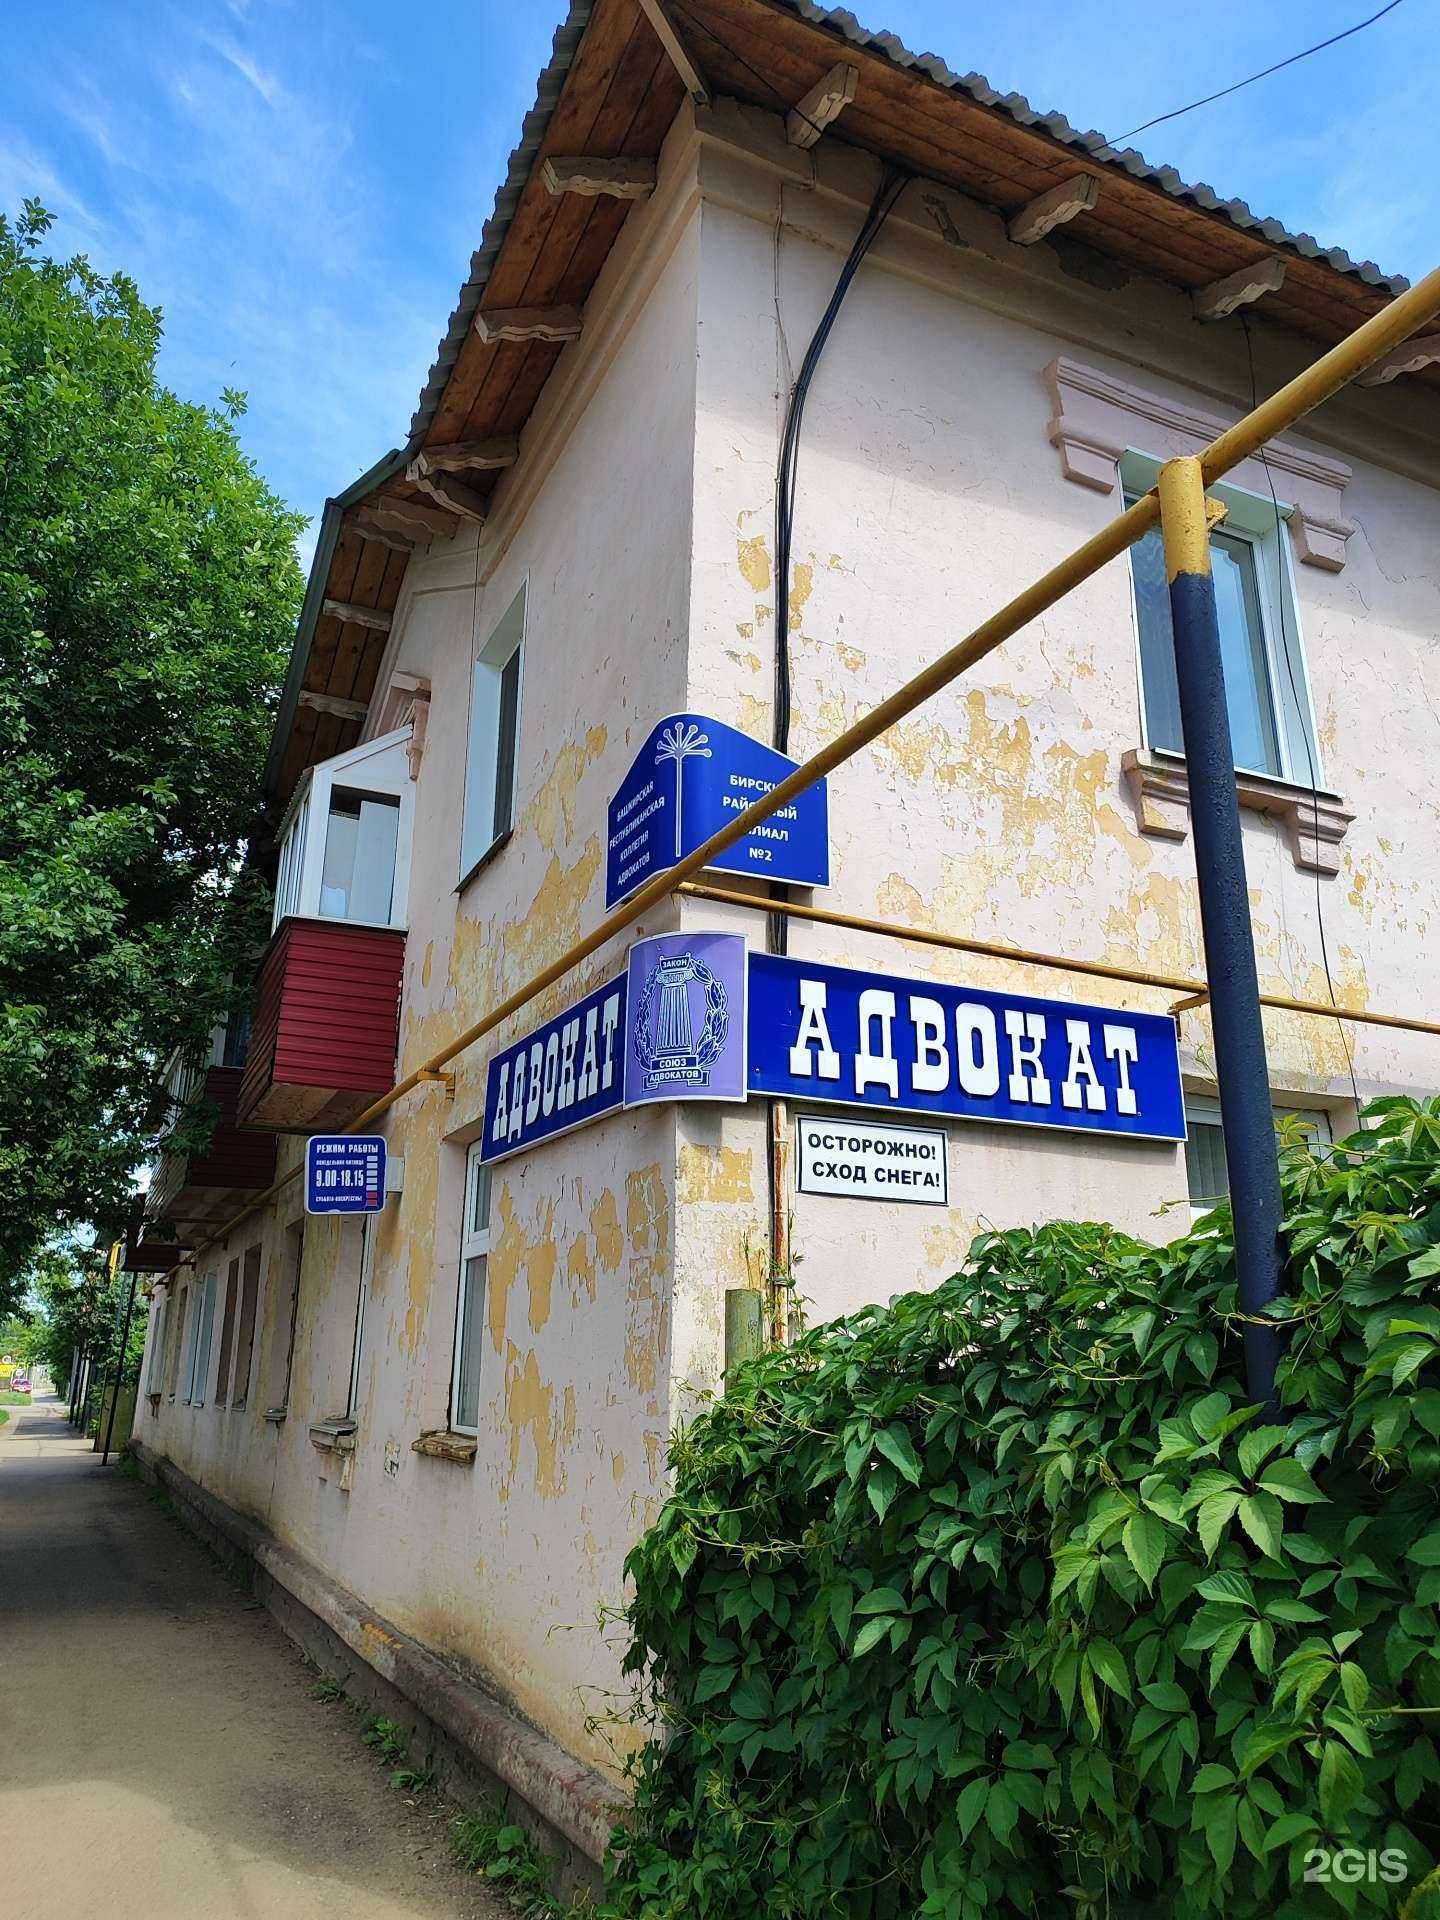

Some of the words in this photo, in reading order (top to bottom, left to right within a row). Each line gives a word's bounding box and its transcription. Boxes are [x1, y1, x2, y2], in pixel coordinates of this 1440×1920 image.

[617, 781, 654, 822] БАШКИРСКАЯ
[609, 796, 665, 851] РЕСПУБЛИКАНСКАЯ
[620, 830, 649, 862] КОЛЛЕГИЯ
[749, 848, 773, 861] №2
[618, 851, 650, 886] АДВОКАТОВ
[662, 959, 688, 969] ЗАКОН
[789, 979, 1138, 1115] АДВОКАТ
[493, 992, 620, 1143] АДВОКАТ
[650, 1071, 699, 1082] АДВОКАТОВ
[659, 1058, 687, 1069] СОЮЗ
[316, 1144, 346, 1153] РЕЖИМ
[348, 1144, 378, 1153] РАБОТЫ
[808, 1133, 936, 1160] ОСТОРОЖНО!
[316, 1169, 364, 1187] 9.00-18.15
[812, 1162, 867, 1183] СХОД
[874, 1168, 940, 1187] СНЕГА!
